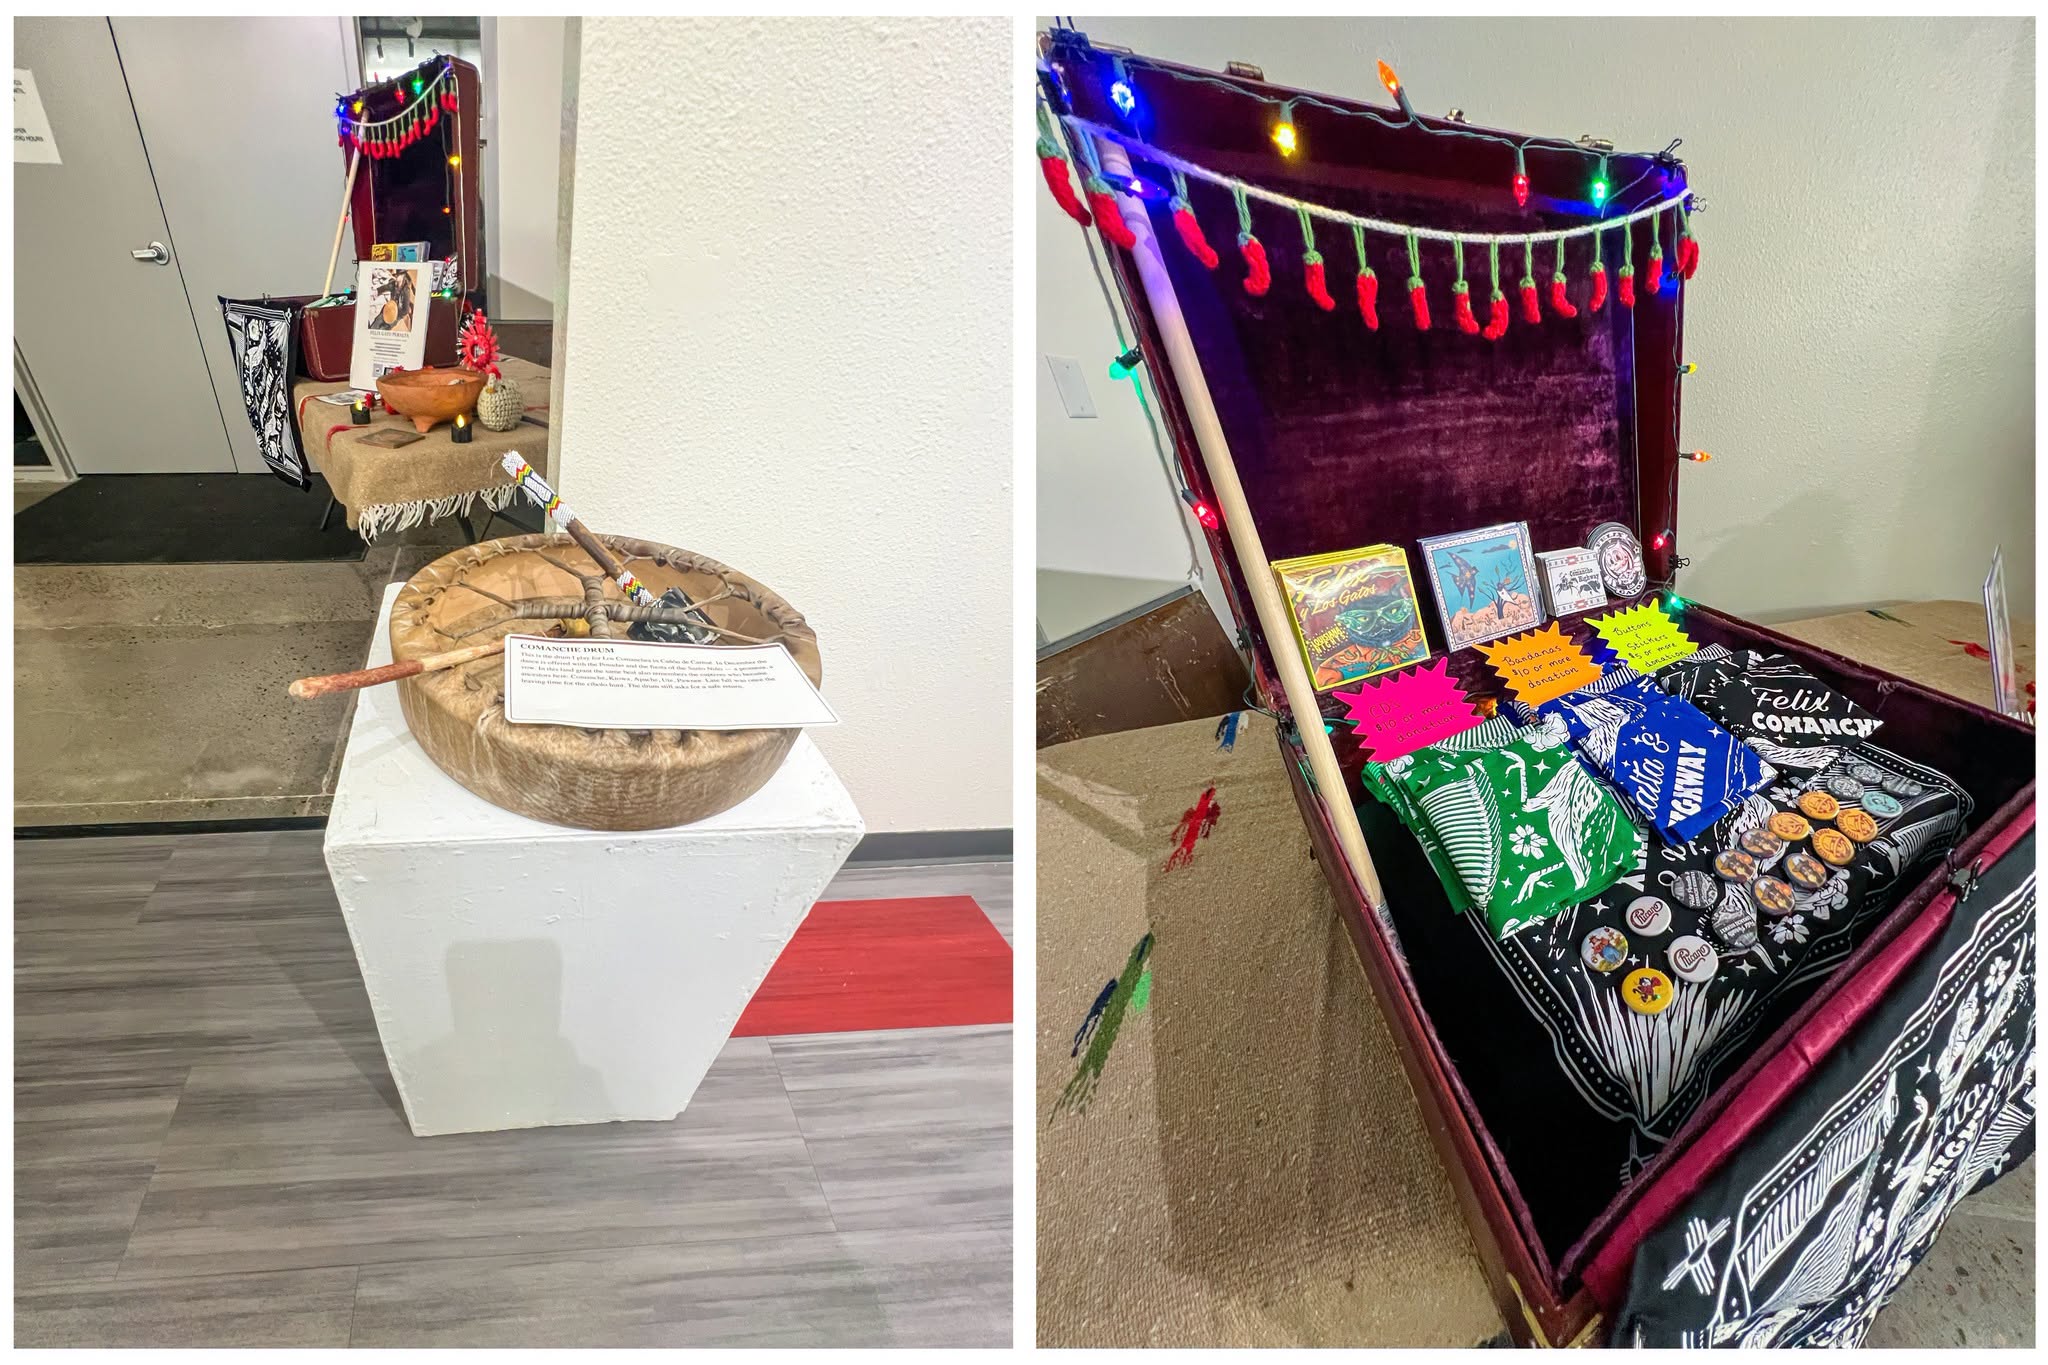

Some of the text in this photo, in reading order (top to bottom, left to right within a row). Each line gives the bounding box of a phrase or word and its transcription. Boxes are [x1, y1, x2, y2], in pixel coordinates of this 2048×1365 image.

[1619, 580, 1644, 596] GATOS
[1312, 597, 1336, 616] Los
[1339, 583, 1377, 606] Gatos
[1311, 626, 1344, 649] LOUISIANA
[1613, 621, 1652, 636] Buttons
[520, 643, 581, 653] COMANCHE
[1316, 634, 1347, 655] NIGHTS
[1626, 634, 1668, 650] Stickers
[1657, 642, 1677, 652] more
[1502, 645, 1562, 666] Bandanas
[1645, 650, 1688, 668] donation
[1512, 656, 1571, 678] $10 or more
[1528, 667, 1579, 689] donation
[1751, 687, 1831, 713] Felix
[1375, 700, 1454, 732] $10 or more
[1397, 714, 1457, 743] donation
[1629, 757, 1665, 821] alta
[1630, 900, 1664, 929] Chicano
[1674, 943, 1711, 973] Chicano
